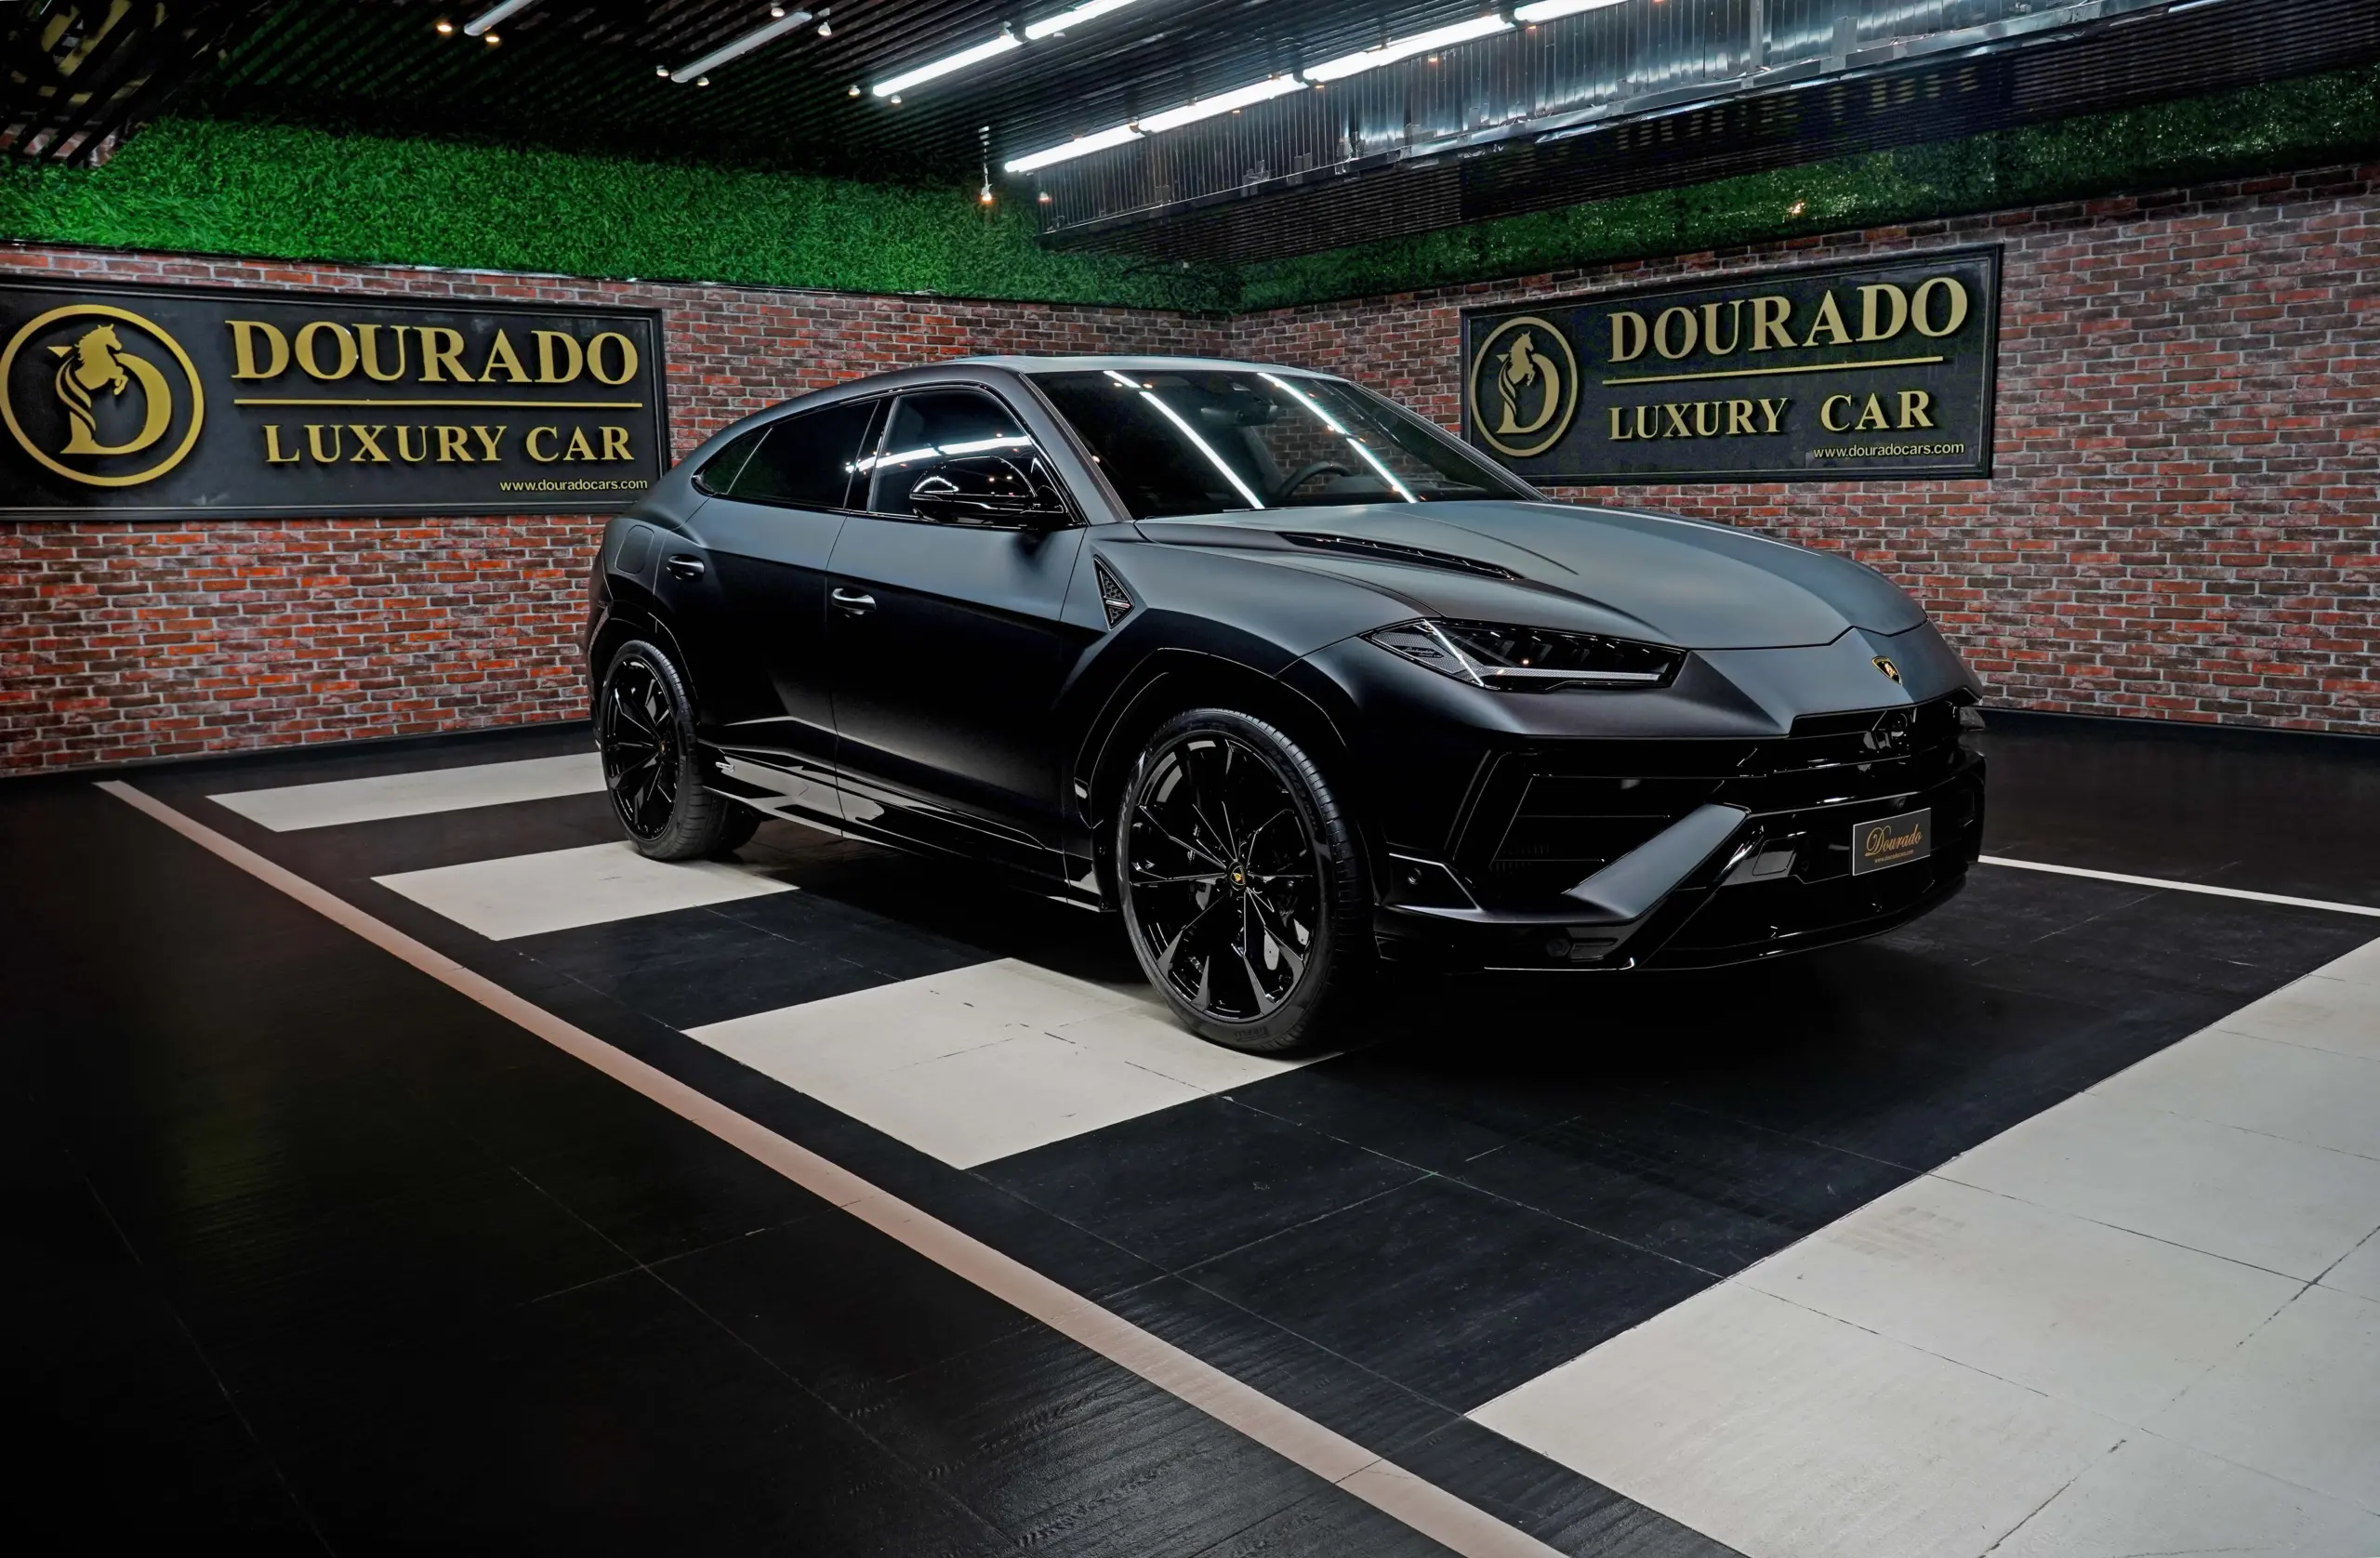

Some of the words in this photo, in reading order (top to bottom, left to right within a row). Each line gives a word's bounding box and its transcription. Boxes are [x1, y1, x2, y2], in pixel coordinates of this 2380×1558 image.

[1606, 276, 1969, 363] DOURADO
[224, 319, 640, 386] DOURADO
[1608, 396, 1789, 441] LUXURY
[1819, 390, 1936, 431] CAR
[262, 423, 507, 464] LUXURY
[525, 425, 636, 462] CAR
[1812, 441, 1965, 459] www.douradocars.com
[498, 476, 649, 493] www.douradocars.com
[1864, 823, 1923, 857] Dourado
